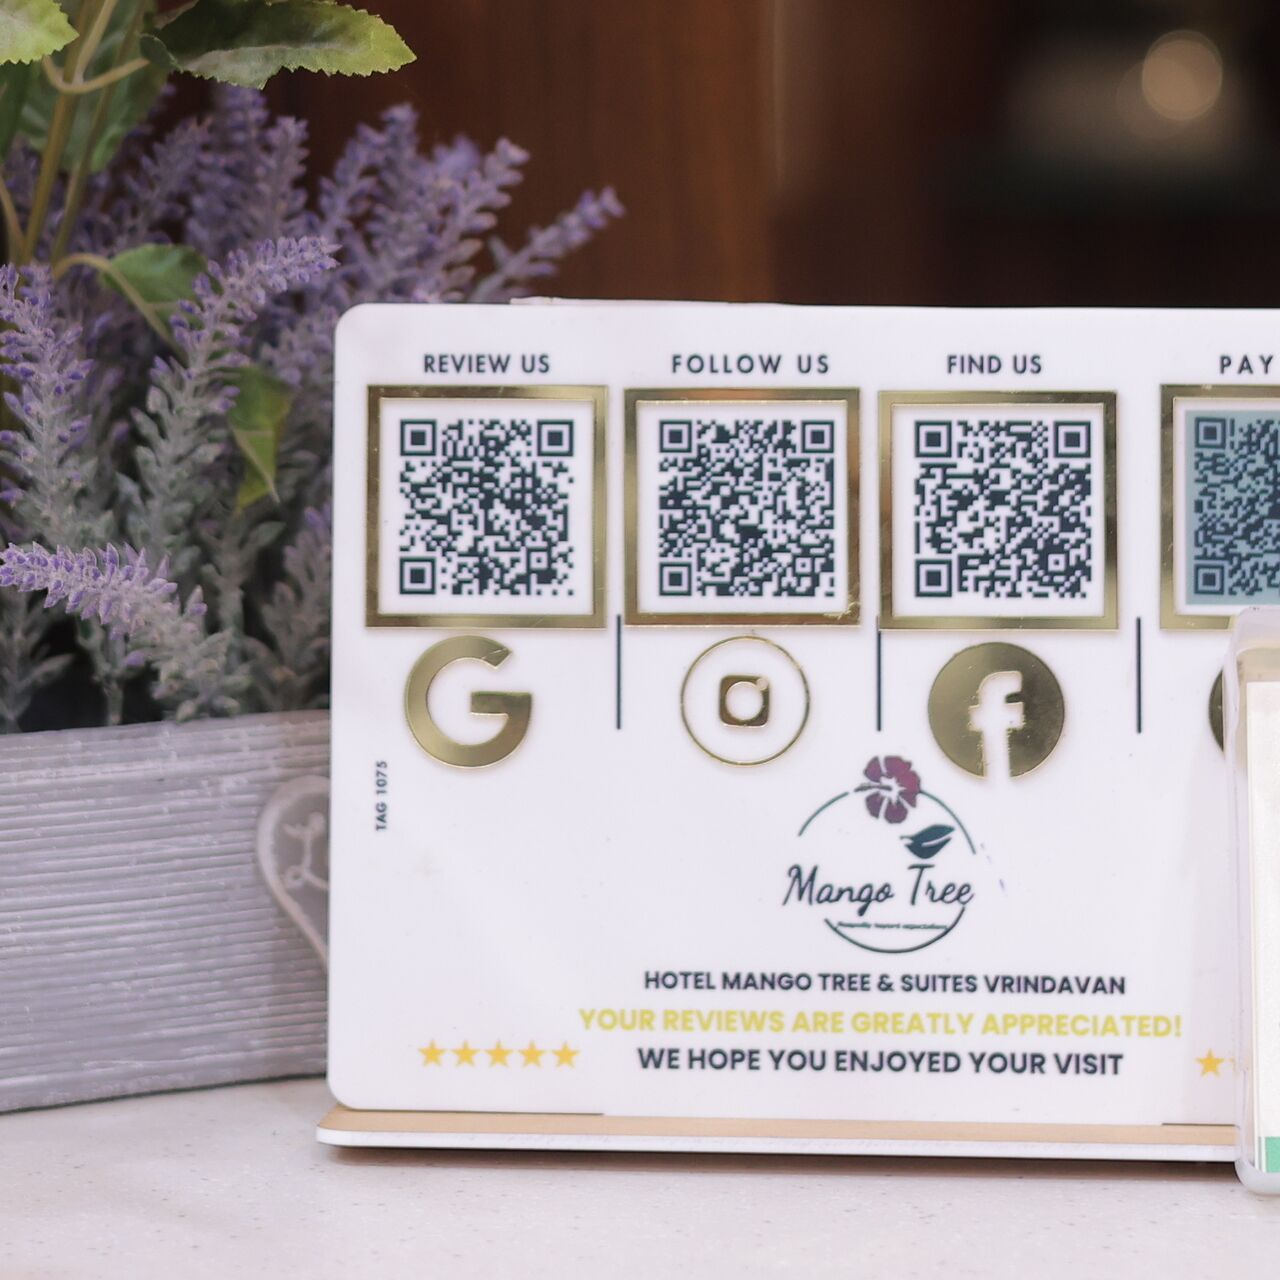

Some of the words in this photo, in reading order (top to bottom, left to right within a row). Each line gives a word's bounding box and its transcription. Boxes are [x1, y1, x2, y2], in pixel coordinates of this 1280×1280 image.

[424, 354, 510, 373] REVIEW
[522, 354, 550, 373] US
[672, 354, 781, 374] FOLLOW
[798, 354, 828, 374] US
[948, 355, 1002, 374] FIND
[1013, 355, 1041, 374] US
[1220, 355, 1273, 374] PAY
[404, 635, 531, 767] G
[376, 761, 387, 795] 1075
[376, 802, 387, 831] TAG
[782, 864, 894, 915] Mango
[902, 864, 974, 905] Tree
[645, 971, 716, 990] HOTEL
[722, 972, 812, 991] MANGO
[820, 973, 870, 991] TREE
[877, 974, 894, 992] &
[901, 974, 978, 993] SUITES
[984, 975, 1125, 994] VRINDAVAN
[580, 1008, 656, 1031] YOUR
[663, 1010, 785, 1033] REVIEWS
[792, 1011, 844, 1033] ARE
[851, 1012, 974, 1035] GREATLY
[982, 1013, 1182, 1038] APPRECIATED!
[638, 1048, 679, 1069] WE
[688, 1049, 760, 1070] HOPE
[768, 1050, 826, 1071] YOU
[835, 1050, 961, 1073] ENJOYED
[969, 1052, 1046, 1074] YOUR
[1053, 1053, 1123, 1075] VISIT
